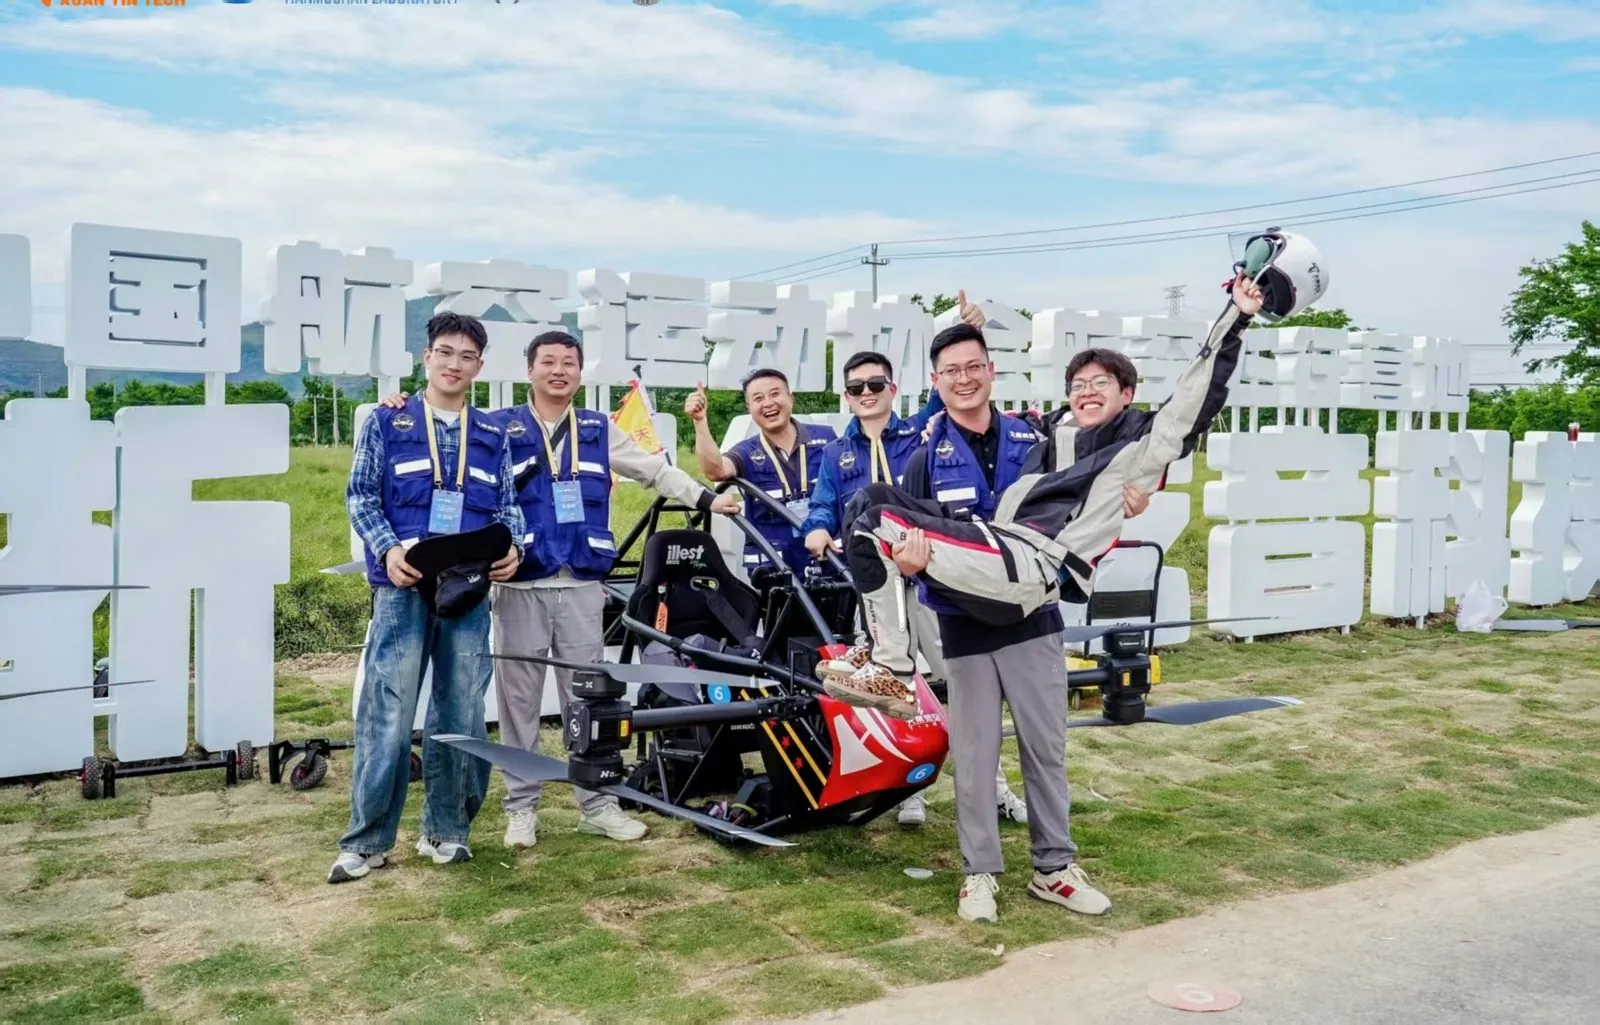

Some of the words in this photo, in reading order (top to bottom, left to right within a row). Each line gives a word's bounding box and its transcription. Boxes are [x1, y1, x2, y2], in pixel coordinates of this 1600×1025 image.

[667, 545, 705, 560] illest
[714, 686, 724, 701] 6
[915, 768, 927, 780] 6
